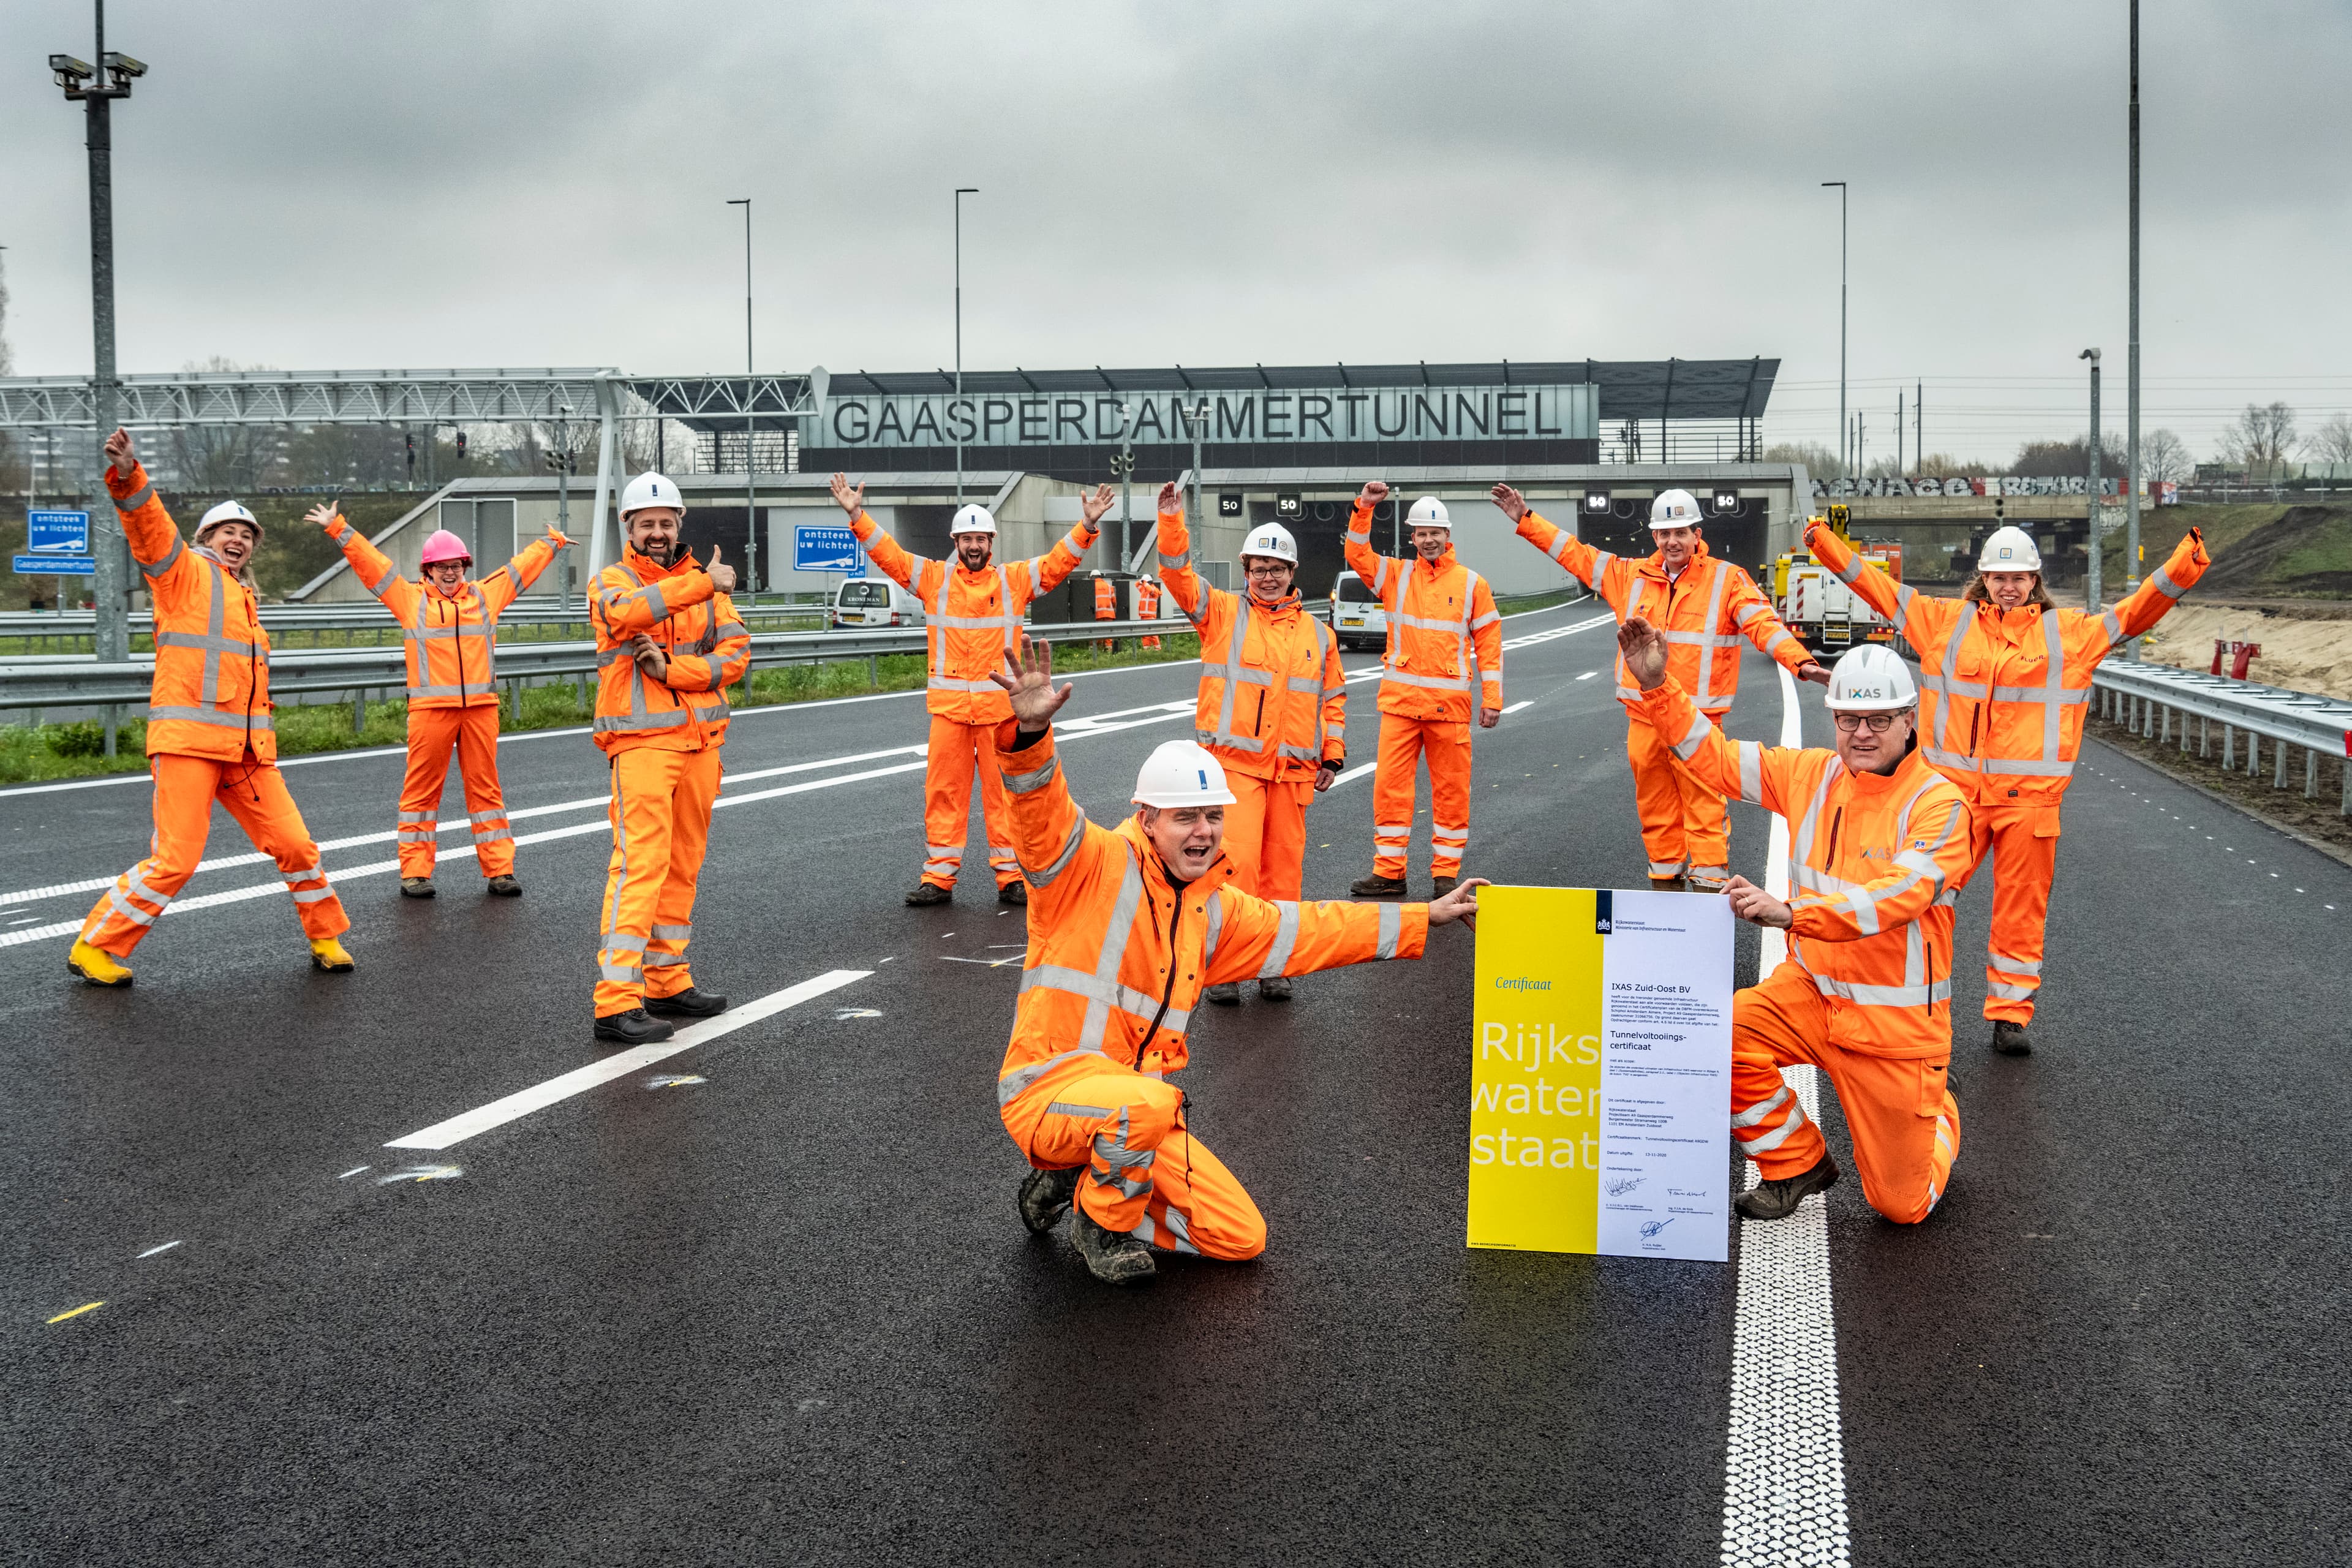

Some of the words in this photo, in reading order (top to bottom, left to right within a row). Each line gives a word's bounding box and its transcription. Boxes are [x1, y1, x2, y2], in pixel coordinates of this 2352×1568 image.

[834, 393, 1562, 443] GAASPERDAMMERTUNNEL
[1223, 500, 1237, 510] 50
[1281, 500, 1296, 509] 50
[1589, 497, 1605, 507] 50
[1718, 496, 1733, 505] 50
[818, 541, 854, 549] lichten
[1849, 688, 1881, 698] IXAS
[1496, 977, 1551, 992] Certificaat
[1635, 984, 1676, 992] Zuid-Oost
[1610, 1030, 1687, 1042] Tunnelvoltooiings-
[1482, 1022, 1599, 1072] Rijks
[1471, 1078, 1601, 1117] water
[1472, 1128, 1598, 1170] staat
